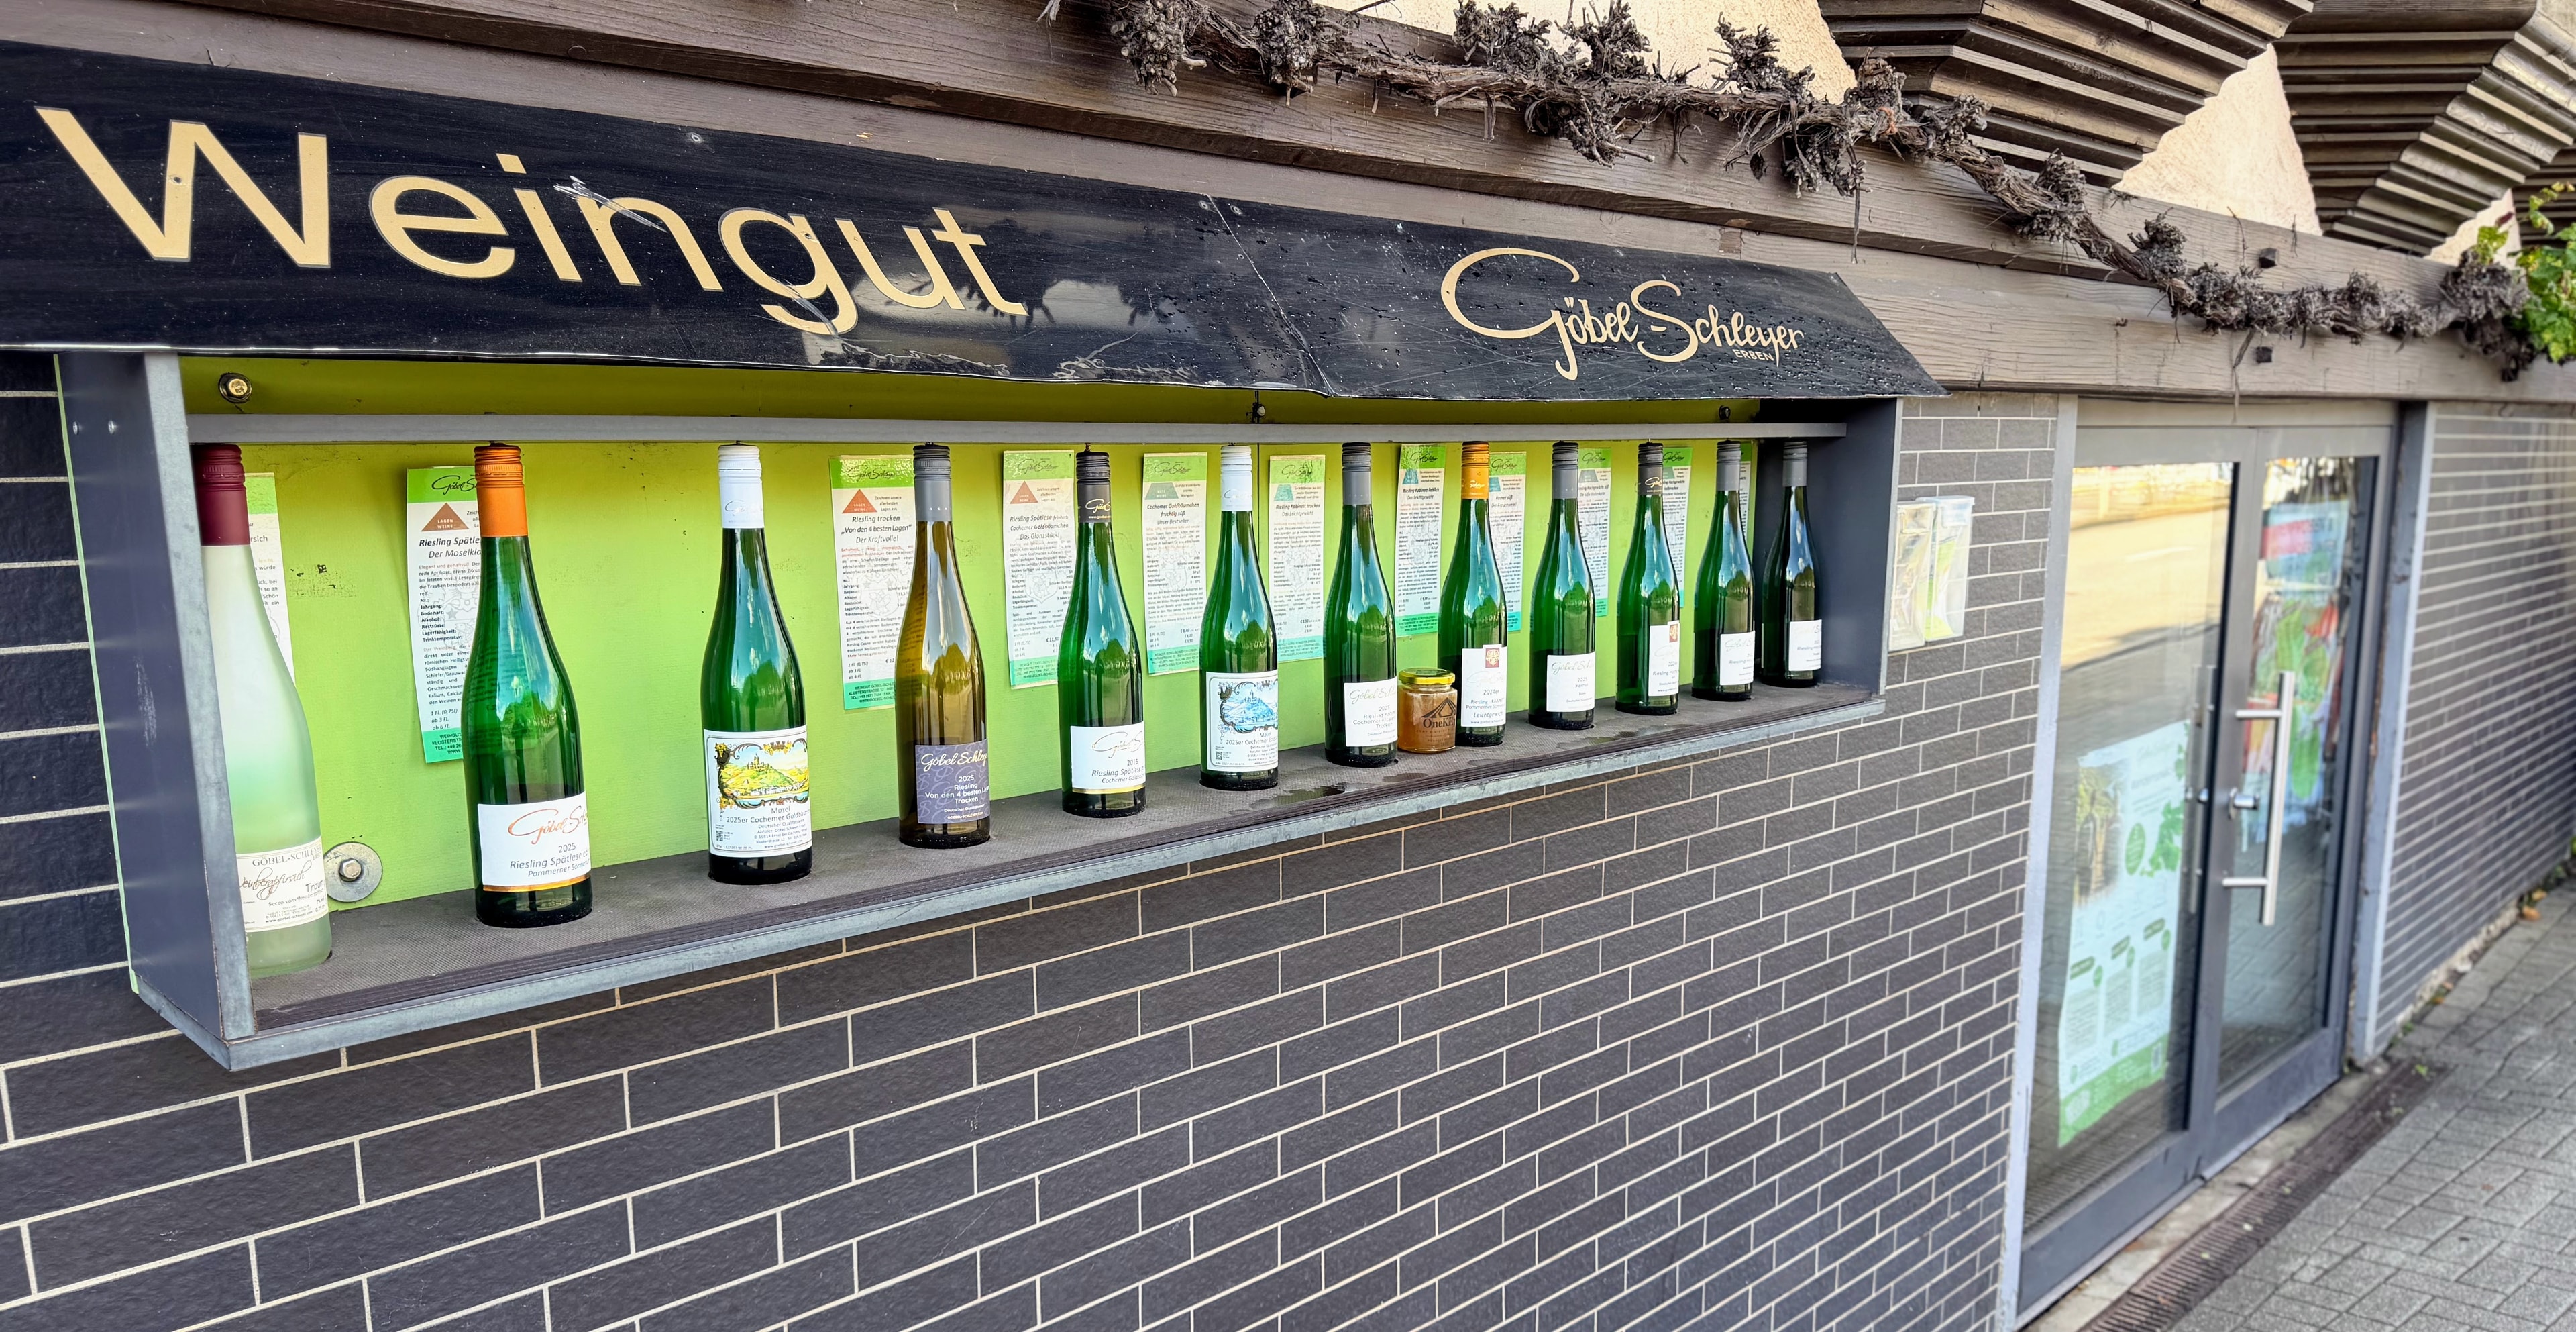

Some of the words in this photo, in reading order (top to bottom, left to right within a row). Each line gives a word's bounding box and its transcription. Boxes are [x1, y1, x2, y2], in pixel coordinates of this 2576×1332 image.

[34, 106, 1028, 336] Weingut
[1732, 348, 1774, 363] ERBEN
[419, 539, 451, 547] Riesling
[921, 753, 959, 772] Göbel
[955, 783, 978, 791] Riesling
[771, 806, 790, 814] Mosel
[750, 813, 784, 823] Cochemer
[558, 842, 576, 853] 2025
[510, 860, 547, 869] Riesling
[550, 852, 582, 866] Spätlese
[528, 867, 570, 877] Pommerner
